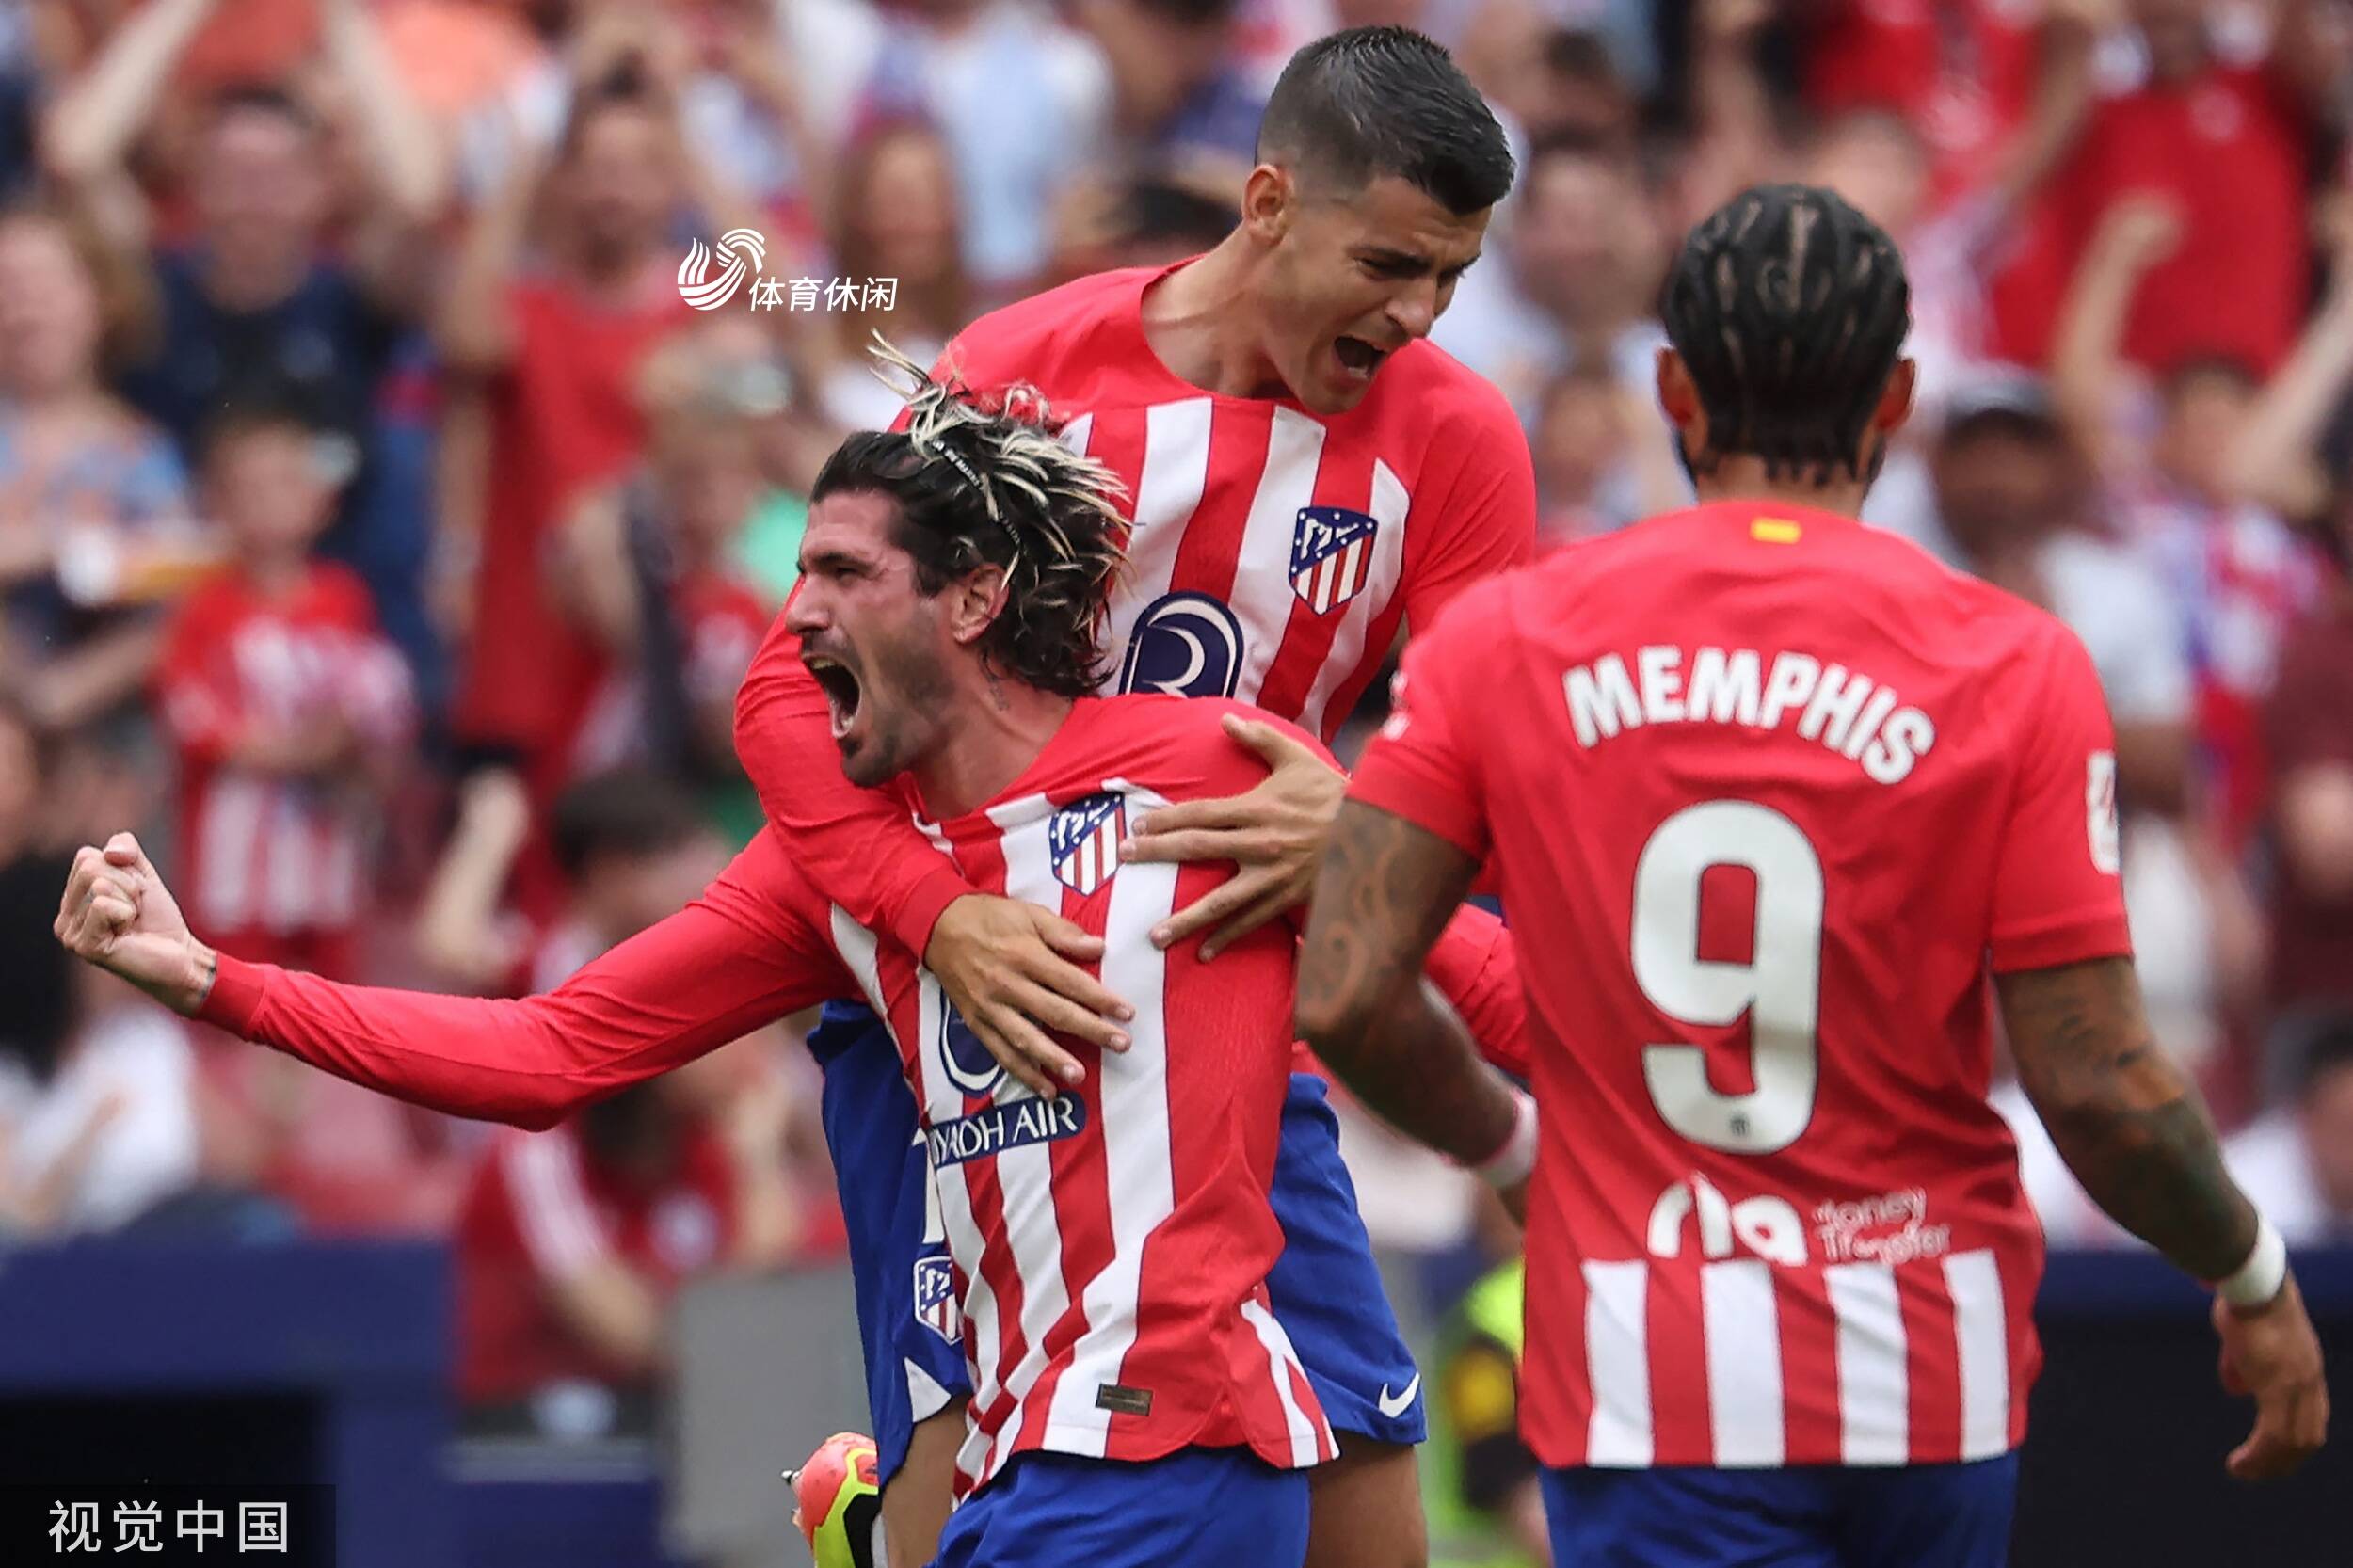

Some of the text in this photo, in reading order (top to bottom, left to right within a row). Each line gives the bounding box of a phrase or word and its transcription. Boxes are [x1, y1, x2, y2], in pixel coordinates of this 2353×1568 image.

[1562, 645, 1935, 784] MEMPHIS
[1630, 799, 1825, 1154] 9
[1013, 1096, 1079, 1143] AIR
